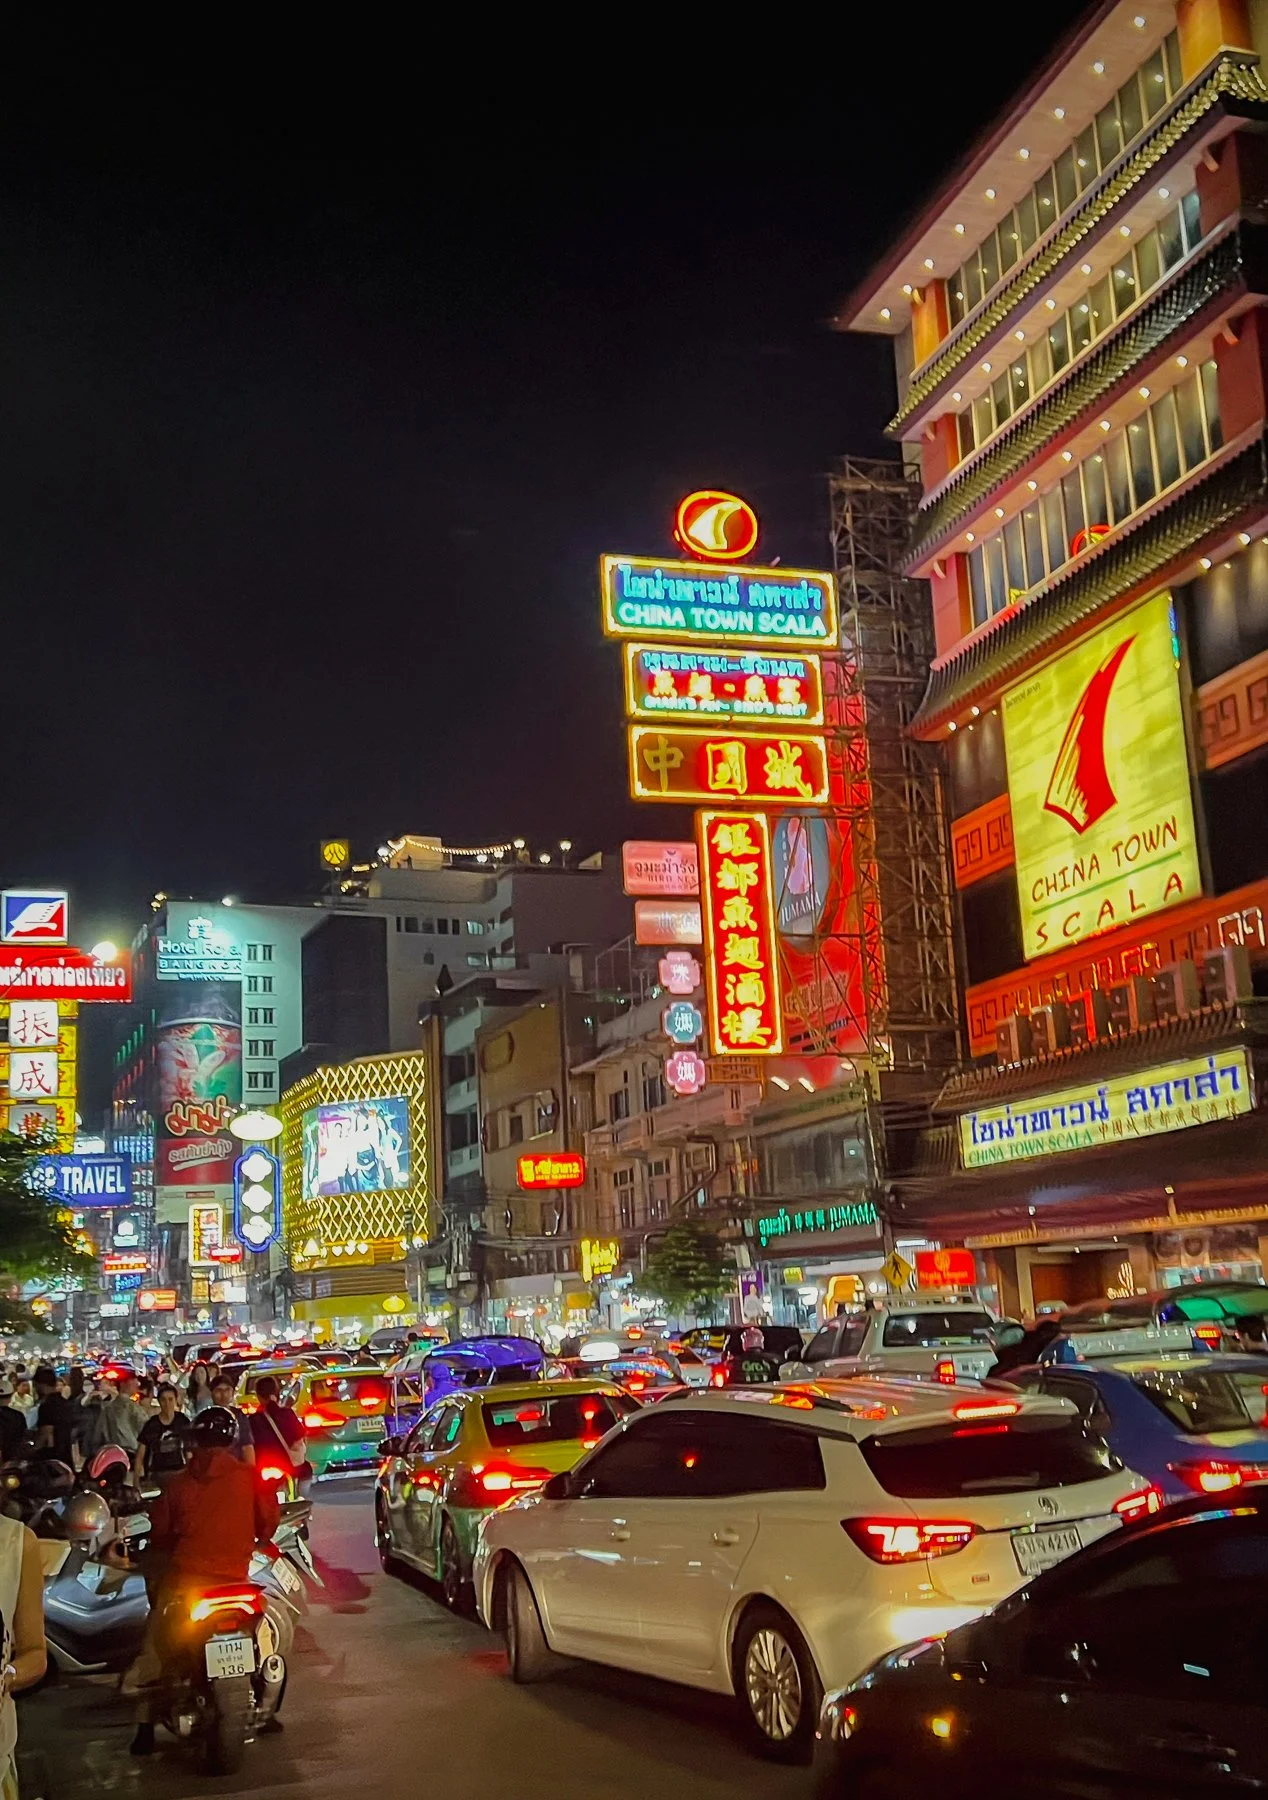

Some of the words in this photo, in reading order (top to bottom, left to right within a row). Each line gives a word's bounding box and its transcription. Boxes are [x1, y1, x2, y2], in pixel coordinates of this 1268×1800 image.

[619, 602, 686, 628] CHINA
[690, 606, 754, 633] TOWN
[758, 612, 827, 636] SCALA
[642, 735, 812, 799] 中國城
[1031, 852, 1100, 903] CHINA
[1111, 814, 1178, 868] TOWN
[1035, 871, 1184, 951] SCALA
[158, 939, 198, 955] Hotel
[967, 1085, 1110, 1145] ไชน่าทาวน์
[1126, 1056, 1240, 1115] สกาล่า
[968, 1147, 1006, 1164] CHINA
[1008, 1137, 1046, 1158] TOWN
[1047, 1128, 1094, 1151] SCALA
[61, 1166, 126, 1194] TRAVEL
[829, 1202, 878, 1232] JUMAMA
[221, 1663, 245, 1676] 136
